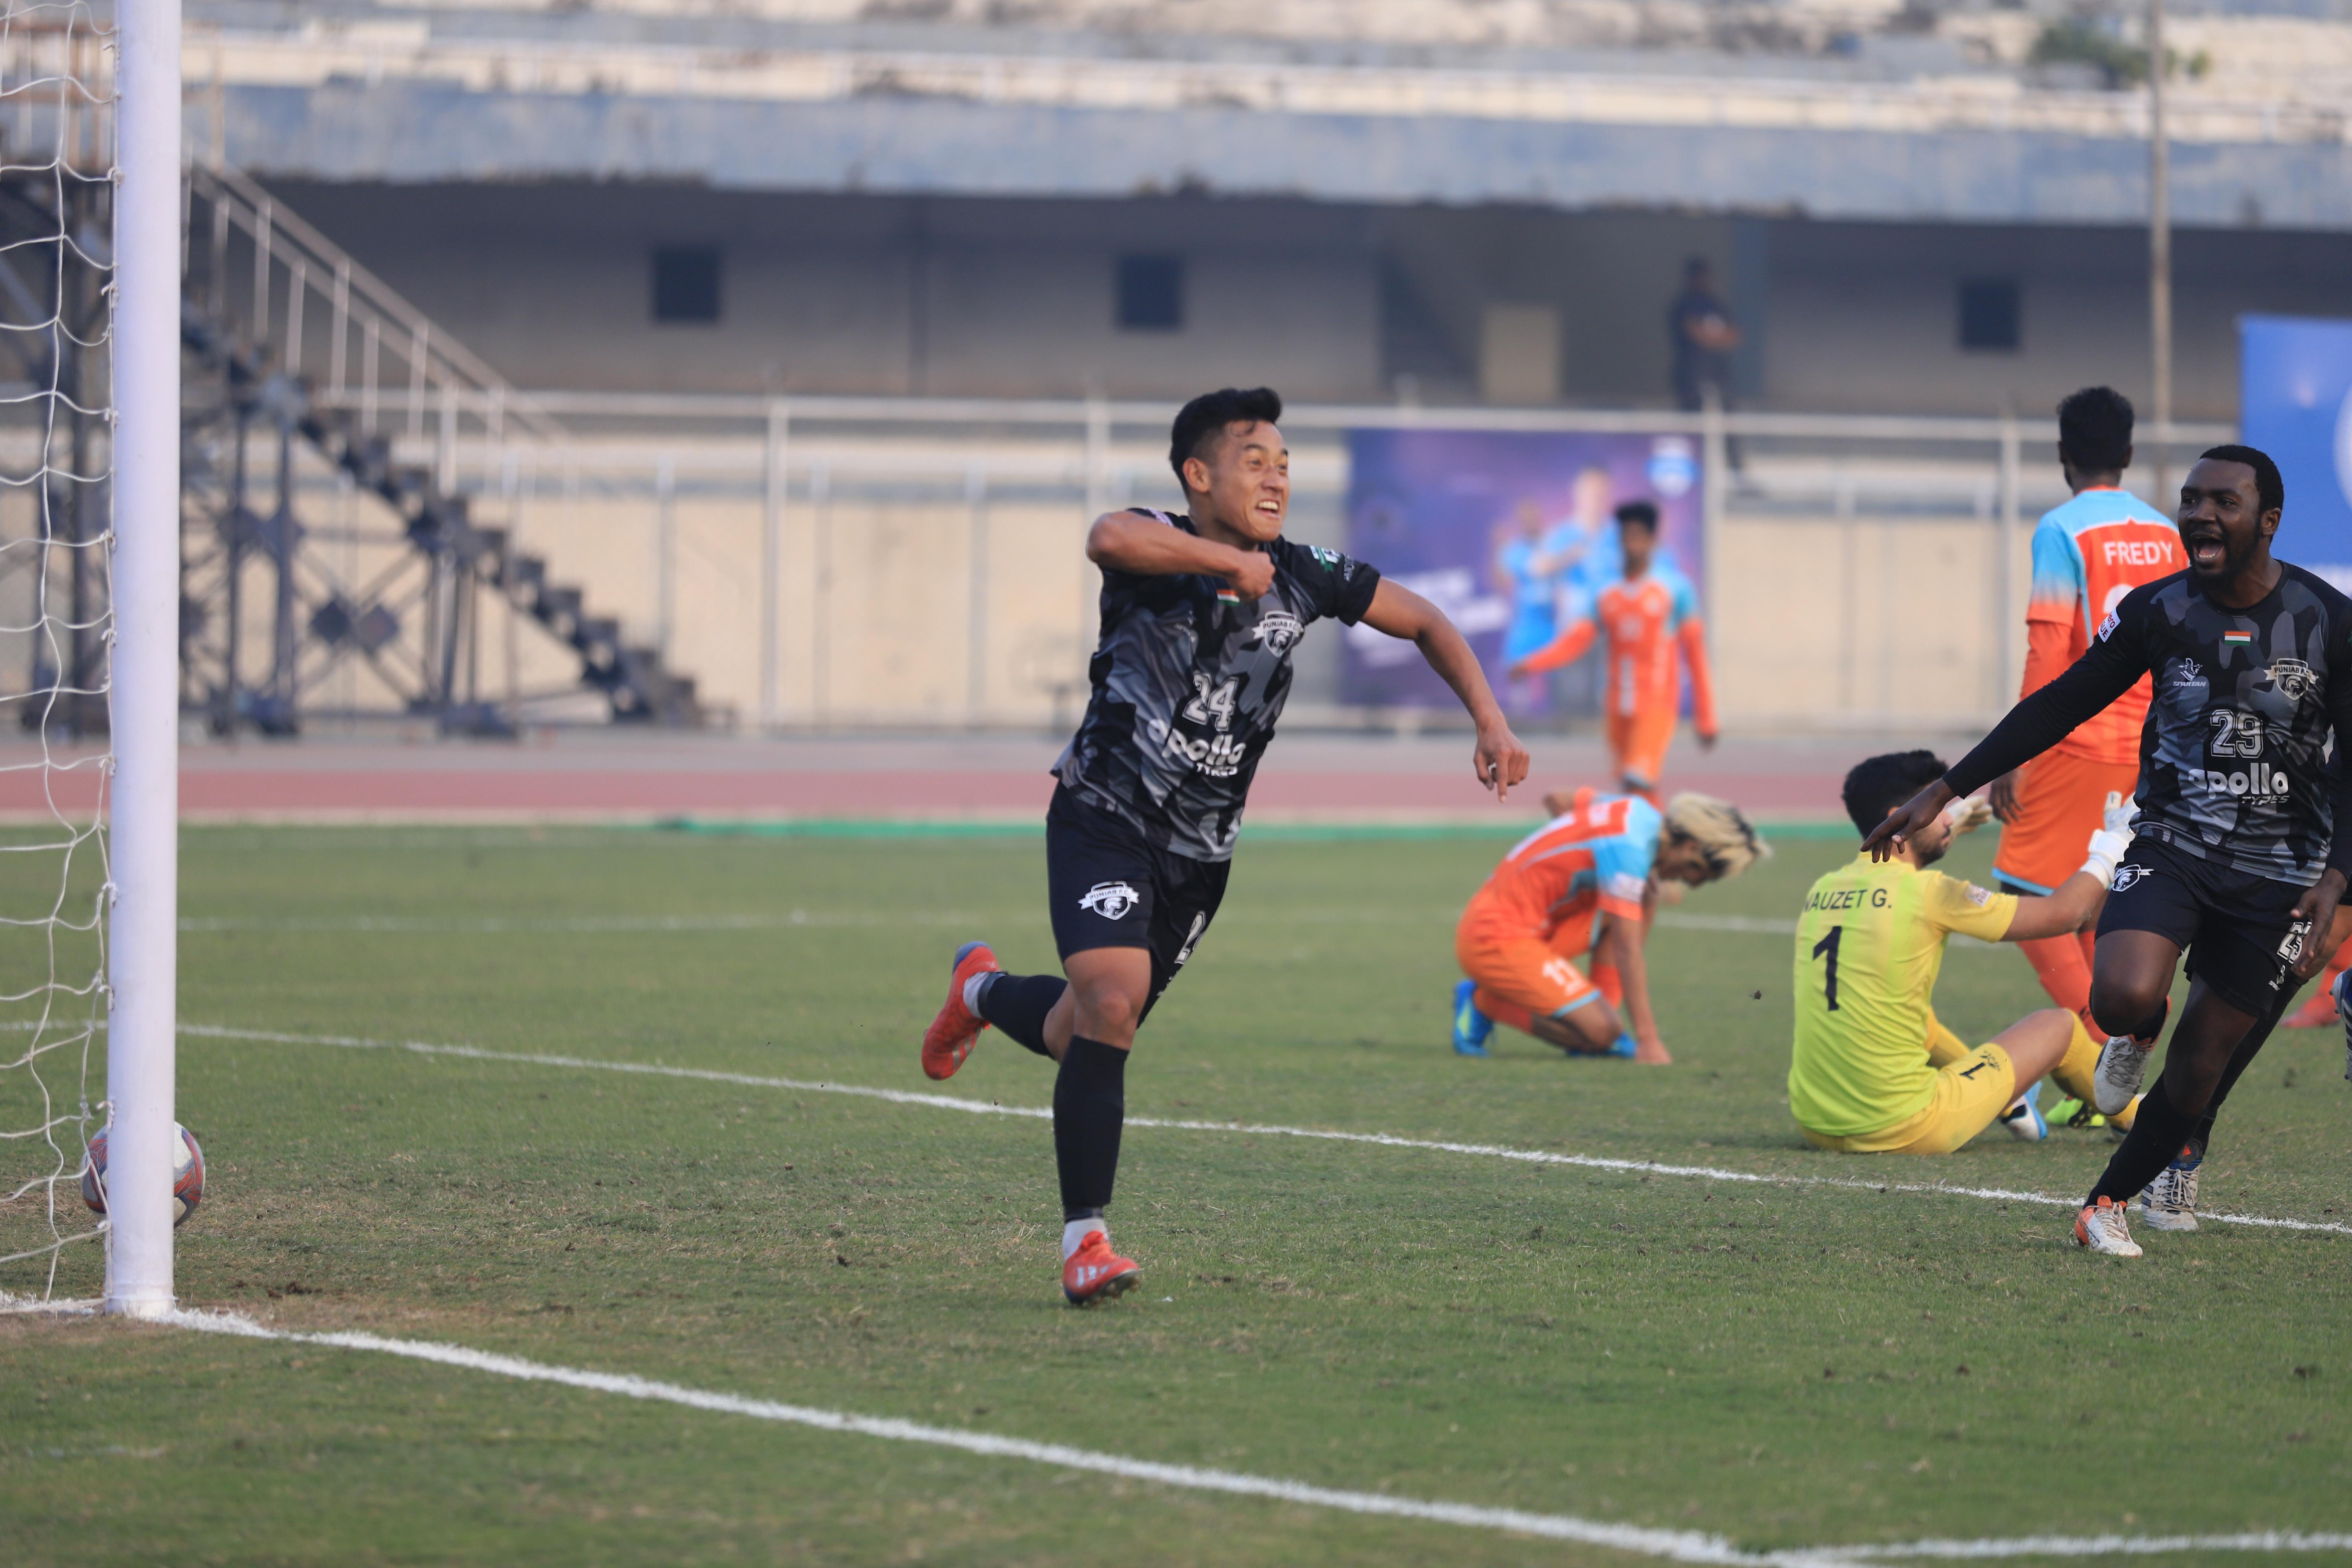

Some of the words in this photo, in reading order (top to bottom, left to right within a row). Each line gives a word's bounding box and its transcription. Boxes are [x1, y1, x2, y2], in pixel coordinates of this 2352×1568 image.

[2103, 541, 2173, 565] FREDY
[1182, 670, 1239, 731] 24
[1147, 719, 1246, 765] apollo
[2210, 709, 2264, 758] 29
[2188, 763, 2289, 799] apollo
[2242, 795, 2290, 805] TYRES
[1872, 888, 1892, 909] G.
[1174, 910, 1206, 965] 2
[1812, 926, 1842, 1012] 1
